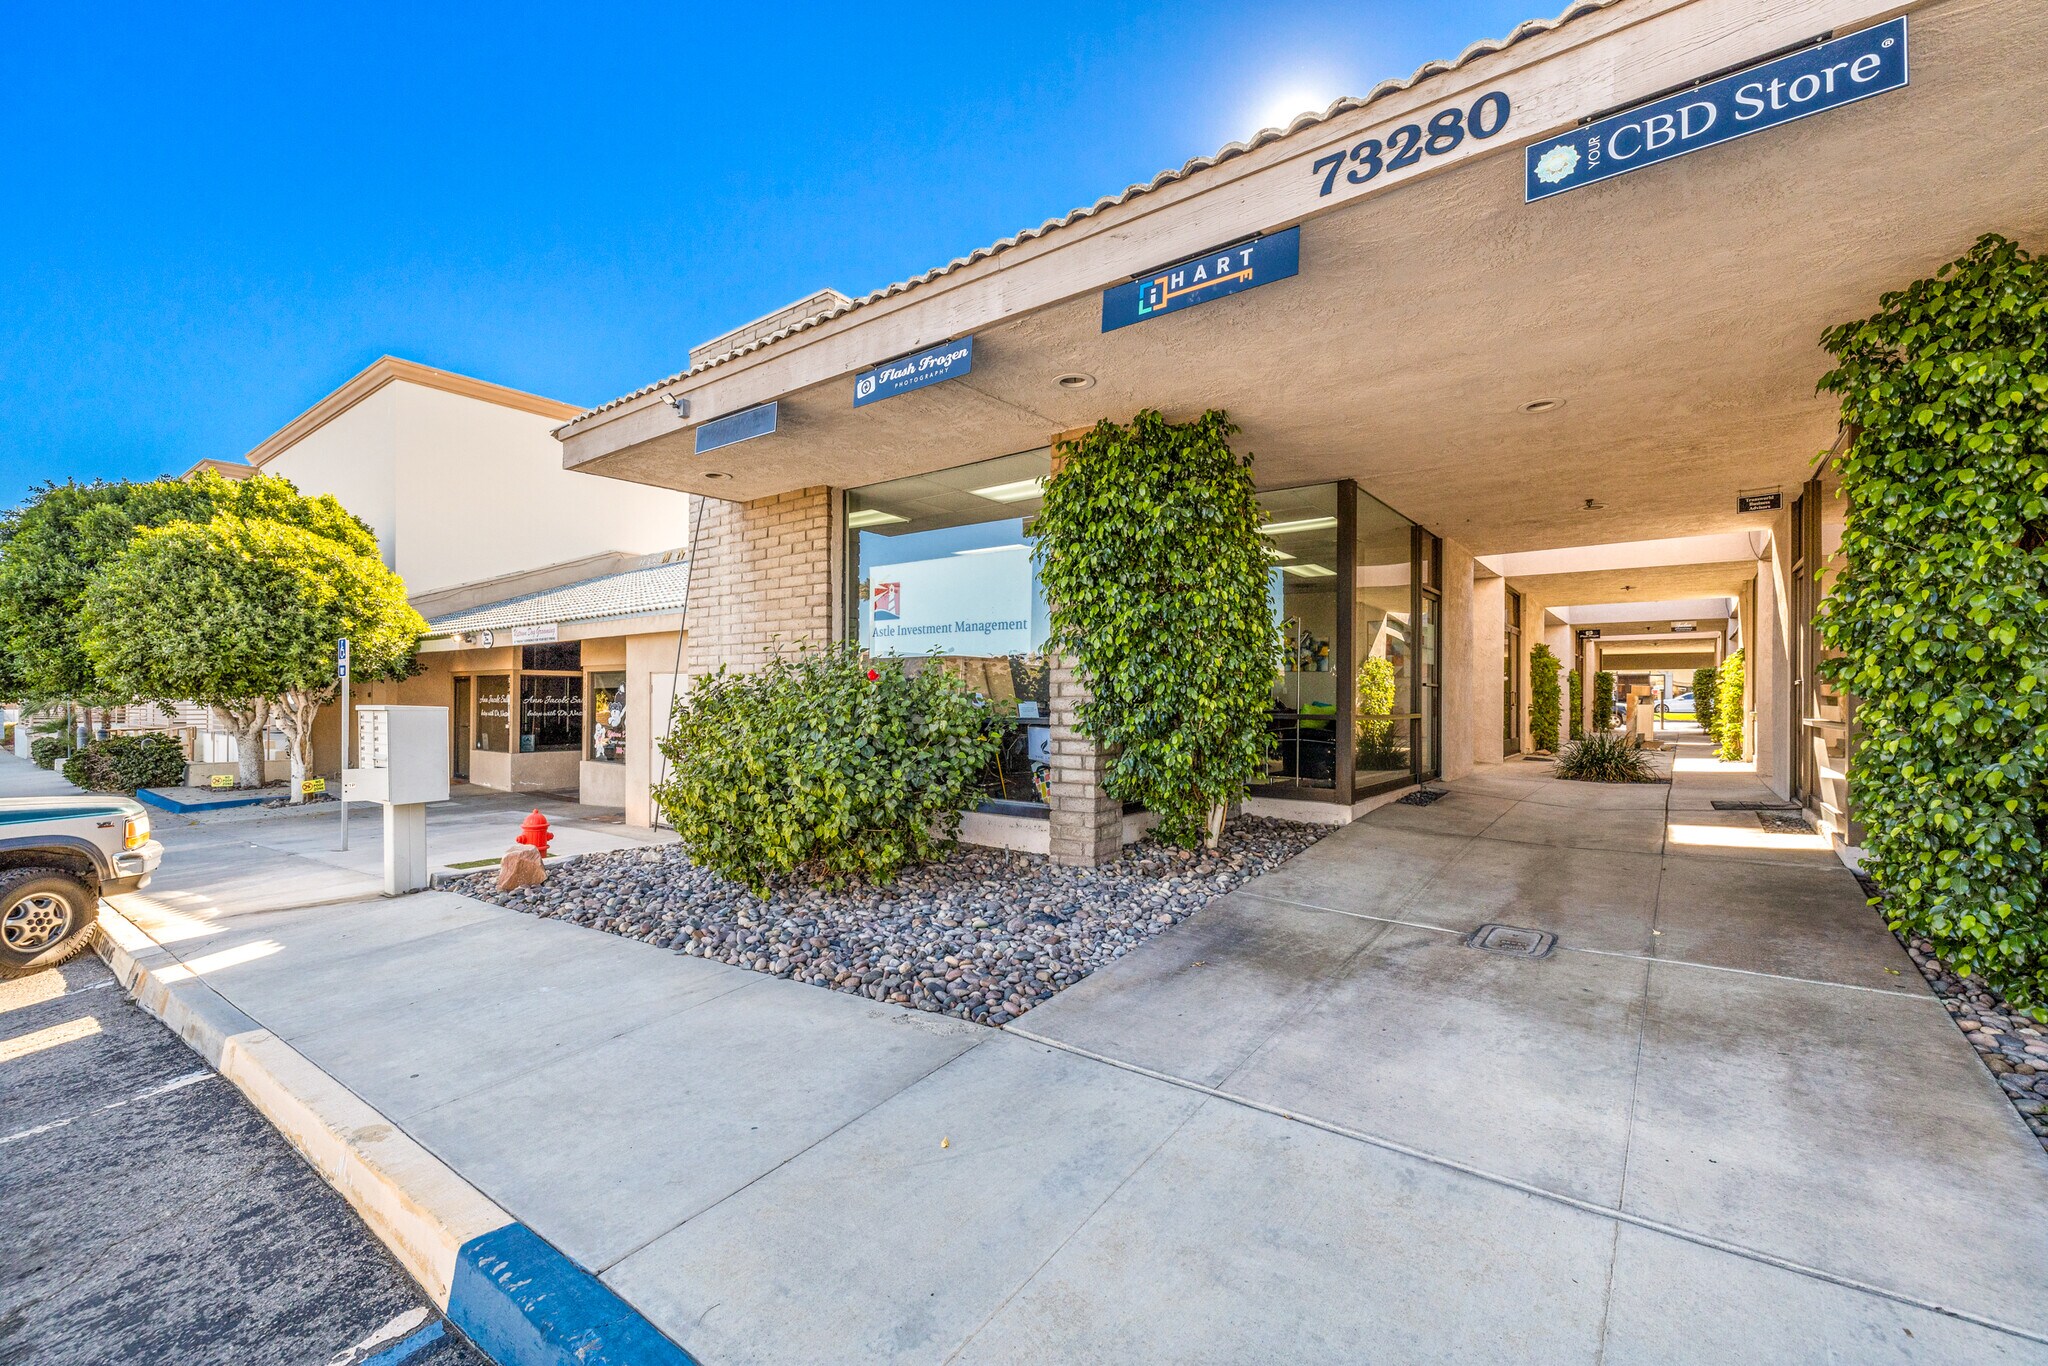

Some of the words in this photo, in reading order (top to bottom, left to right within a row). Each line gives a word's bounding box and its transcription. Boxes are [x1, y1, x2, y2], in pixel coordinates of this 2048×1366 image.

[1313, 91, 1511, 197] 73280
[1588, 136, 1600, 170] YOUR
[1608, 101, 1717, 160] CBD
[1171, 248, 1253, 289] HART
[879, 362, 916, 384] Flash
[918, 348, 968, 373] Frozen
[894, 367, 950, 389] PHOTOGRAPHY
[872, 625, 895, 638] Astle
[897, 623, 952, 637] Investment
[954, 619, 1028, 635] Management
[522, 695, 543, 704] Ann
[544, 695, 570, 705] Jacobs
